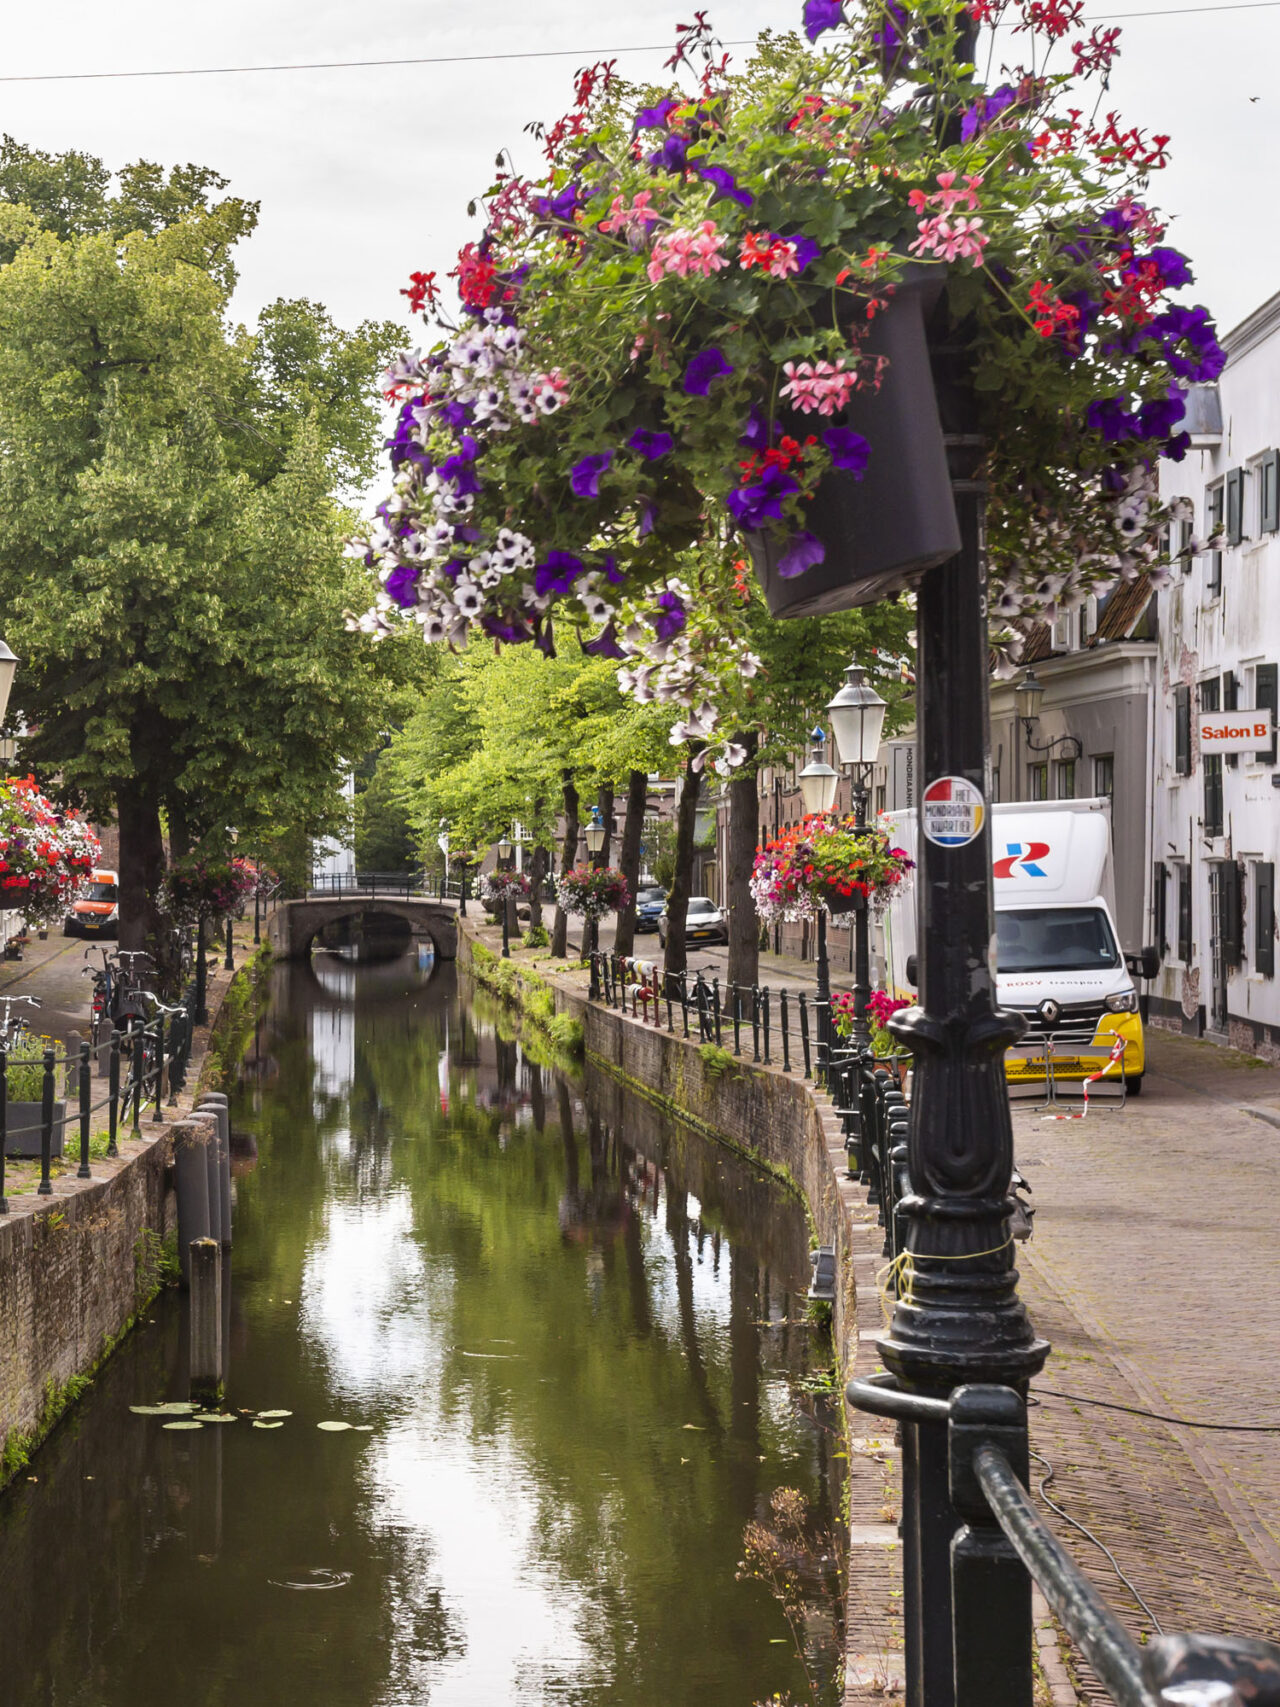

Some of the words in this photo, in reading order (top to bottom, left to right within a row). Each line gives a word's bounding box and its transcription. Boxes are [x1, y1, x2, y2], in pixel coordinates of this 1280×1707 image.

[1201, 725, 1251, 739] Salon
[1253, 723, 1267, 737] B
[955, 789, 971, 802] HET
[925, 804, 971, 818] MONDRIAAN
[931, 820, 970, 833] KWARTIER
